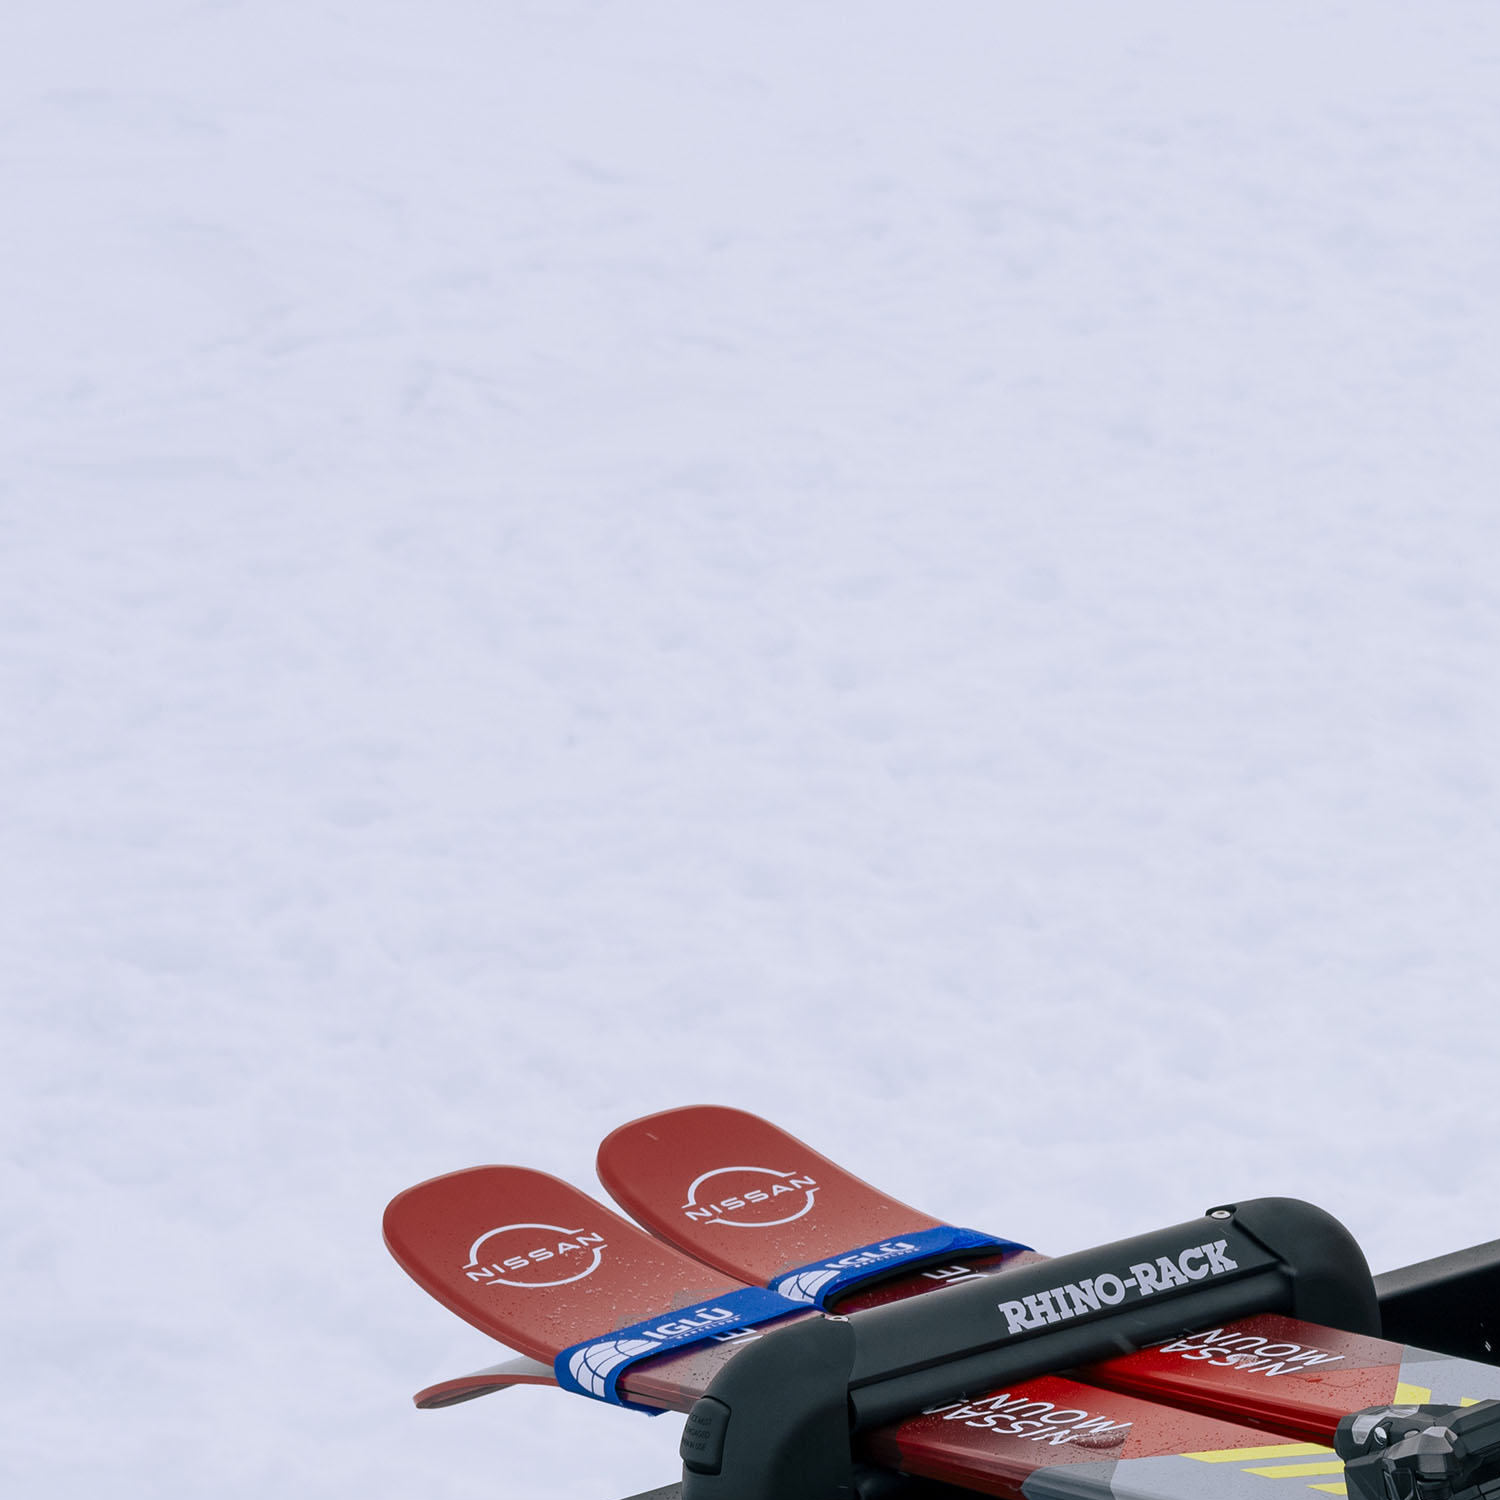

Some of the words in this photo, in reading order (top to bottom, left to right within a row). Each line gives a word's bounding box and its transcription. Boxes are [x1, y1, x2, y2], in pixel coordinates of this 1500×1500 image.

[684, 1176, 817, 1223] NISSAN
[465, 1232, 605, 1282] NISSAN
[998, 1239, 1239, 1334] RHINO-RACK
[1142, 1336, 1304, 1377] NISSA
[1185, 1328, 1346, 1366] MOUN
[972, 1393, 1134, 1434] MOUN
